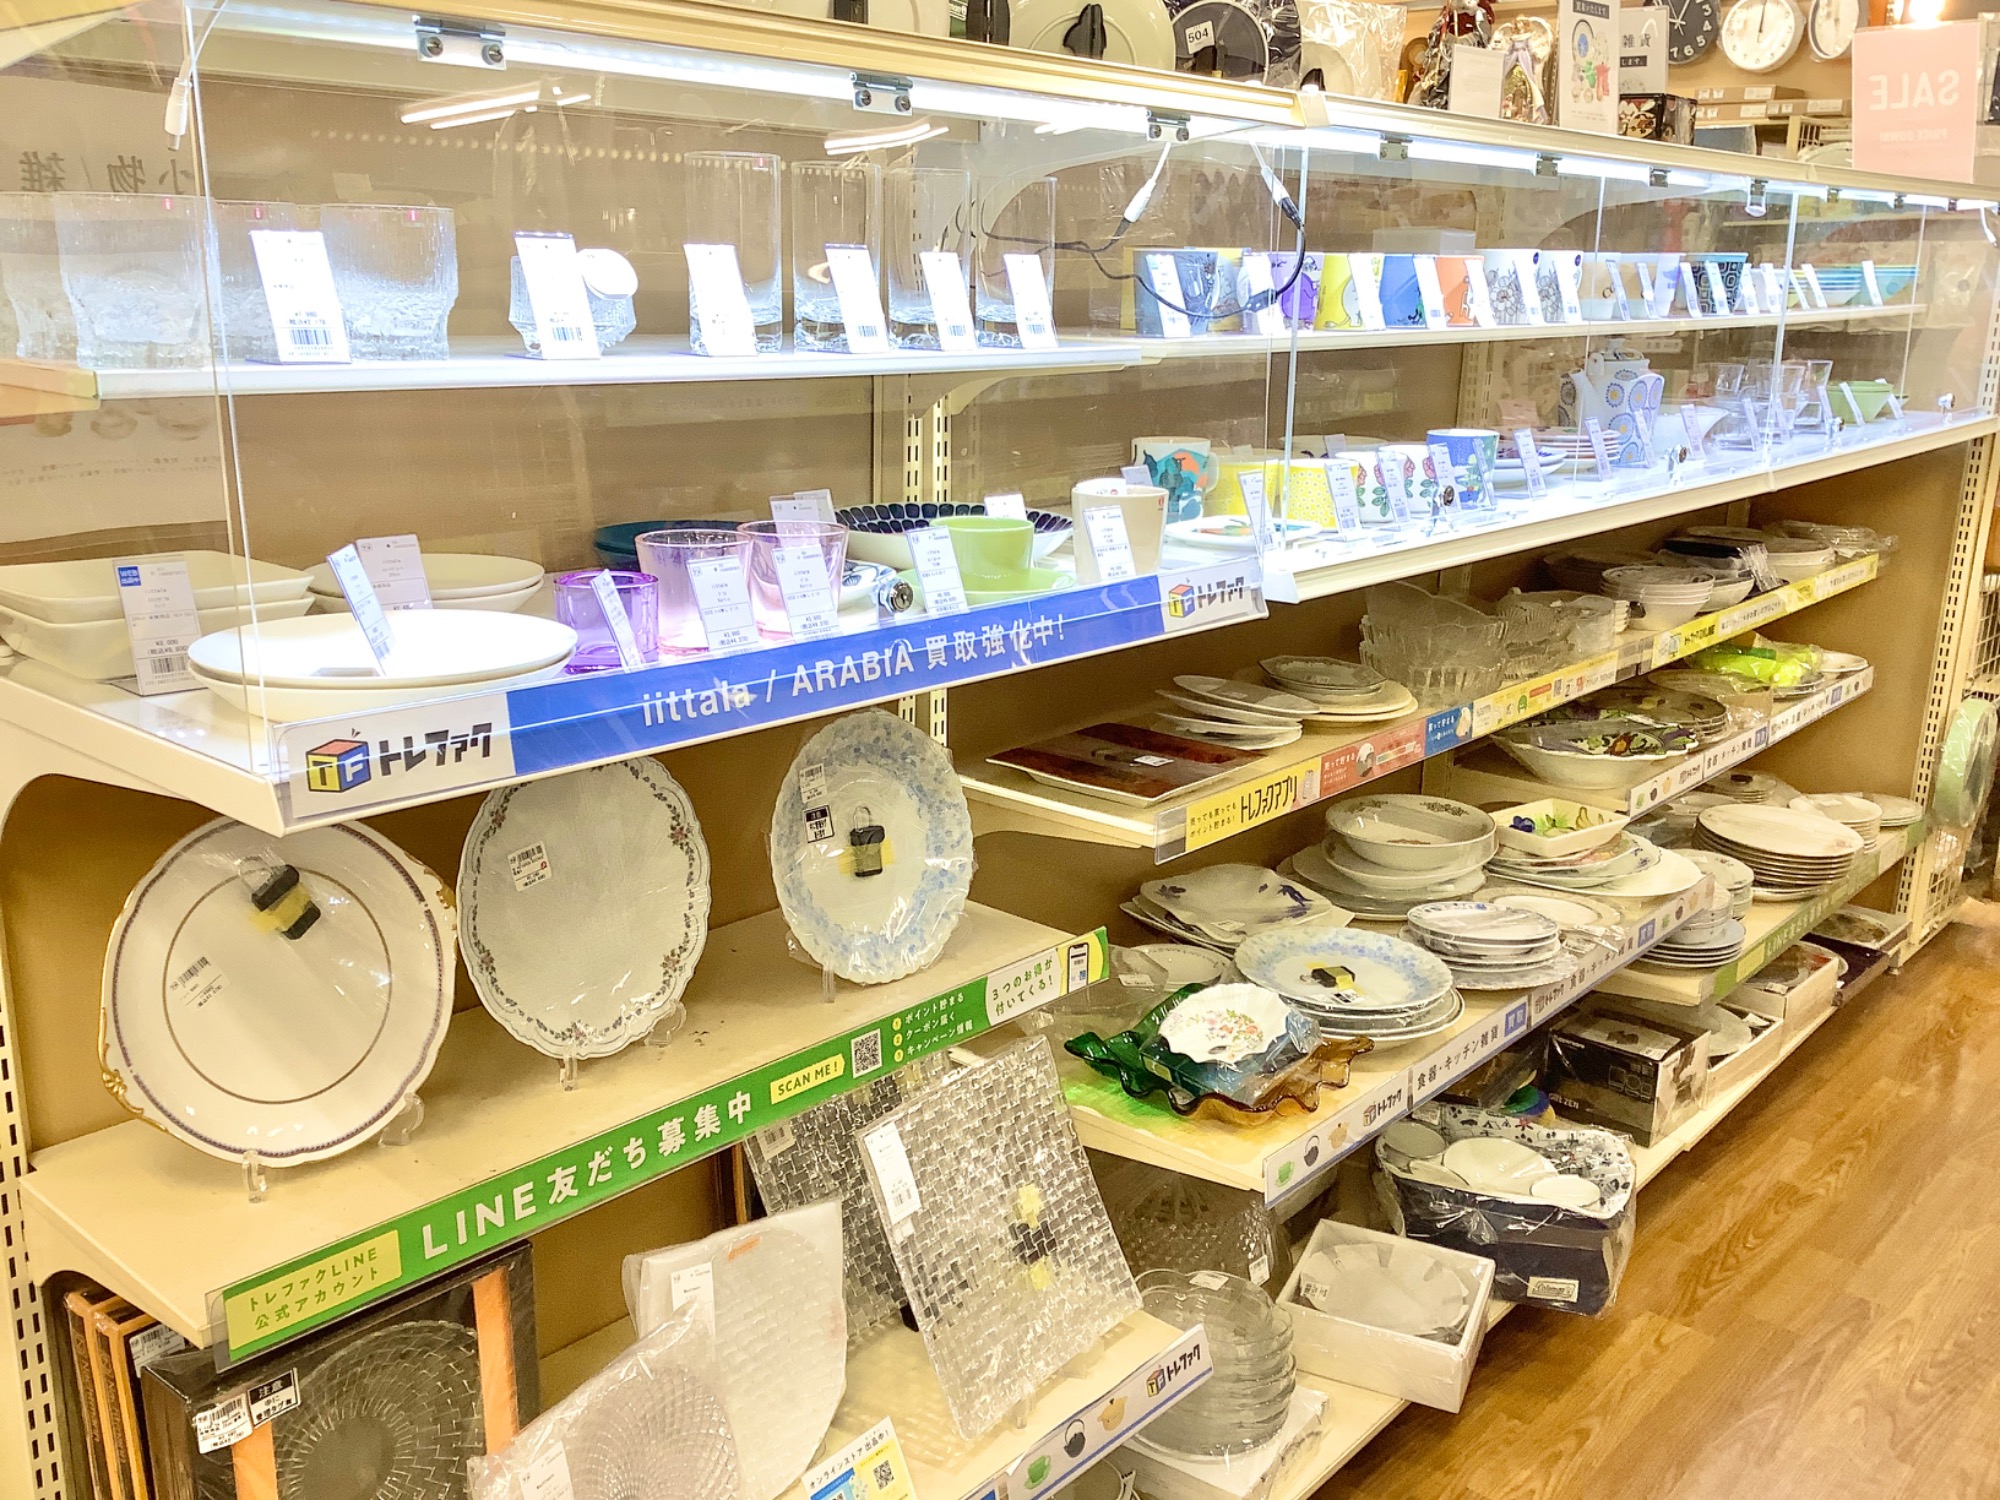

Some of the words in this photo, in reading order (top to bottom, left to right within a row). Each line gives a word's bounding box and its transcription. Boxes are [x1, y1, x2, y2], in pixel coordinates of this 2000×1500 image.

[1188, 27, 1209, 44] 504
[1696, 35, 1706, 47] 5
[1702, 20, 1713, 32] 4
[1670, 47, 1679, 58] 7
[1683, 44, 1694, 56] 6
[120, 569, 138, 577] WEB
[642, 680, 751, 727] iittala
[766, 670, 777, 702] /
[792, 644, 915, 698] ARABIA
[926, 614, 1065, 670] 買取強化中!
[379, 723, 493, 776] トレファク
[1240, 775, 1298, 824] トレファクアプリ
[905, 993, 964, 1024] ポイント貯まる
[995, 975, 1053, 1016] 付いてくる!
[907, 1020, 974, 1056] キャンペーン情報
[778, 1072, 811, 1096] SCAN
[250, 1247, 378, 1312] トレファクLINE
[254, 1267, 378, 1331] 公式アカウント
[1167, 1344, 1201, 1382] トレファク
